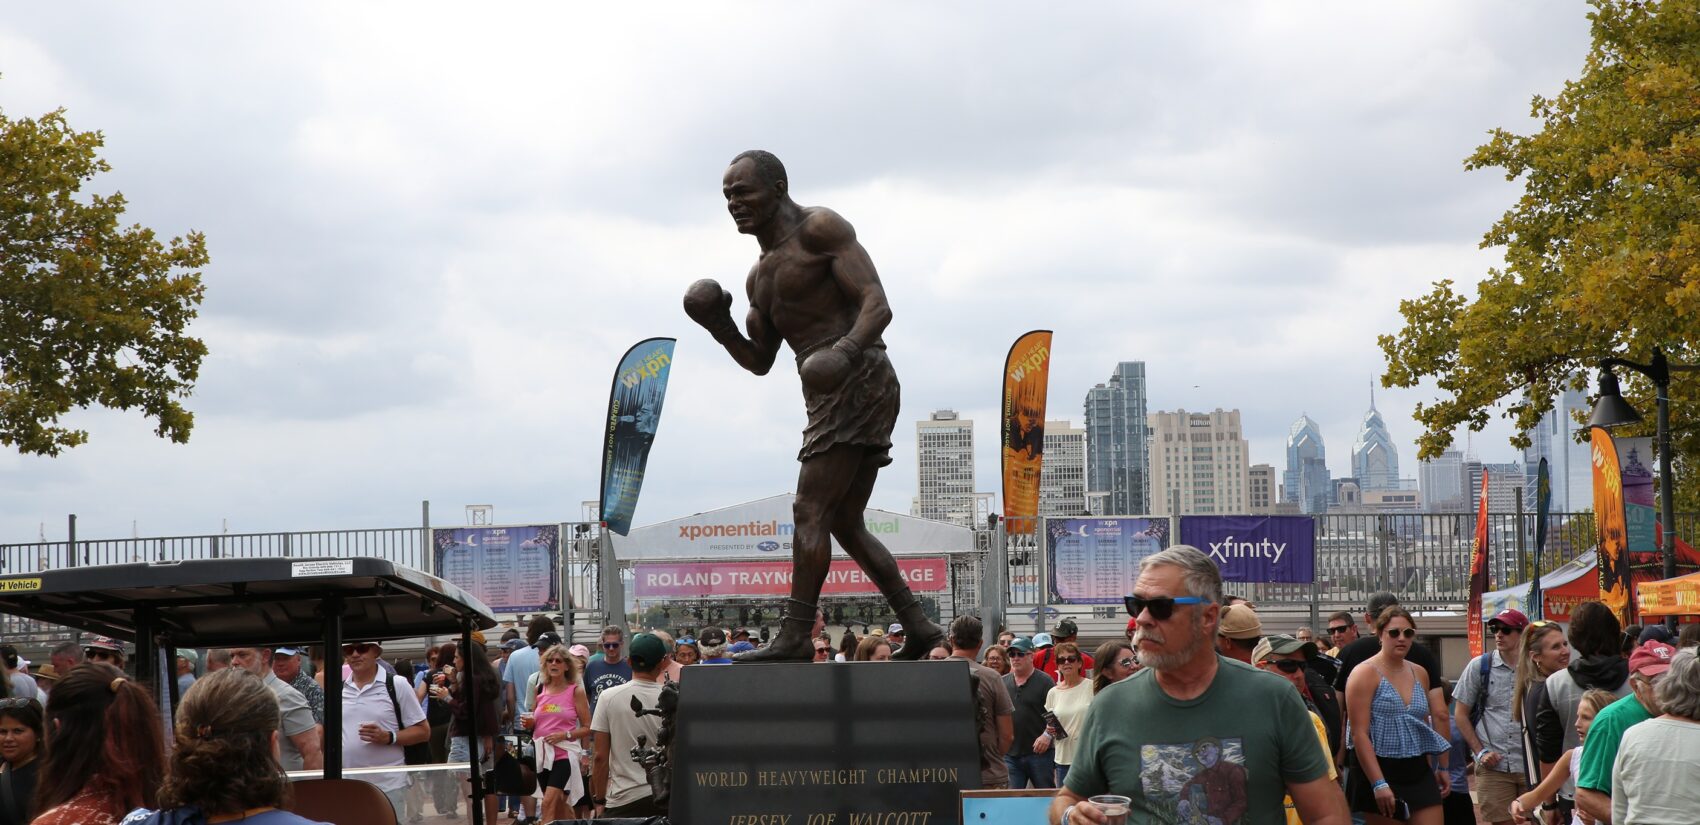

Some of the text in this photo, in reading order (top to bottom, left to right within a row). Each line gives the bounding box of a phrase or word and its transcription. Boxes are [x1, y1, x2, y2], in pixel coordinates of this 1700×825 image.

[621, 353, 671, 389] wxpn
[1011, 346, 1049, 383] wxpn
[1190, 419, 1211, 427] Hilton
[1592, 445, 1621, 498] wxpn
[1208, 536, 1287, 564] xfinity
[8, 580, 38, 590] Vehicle
[647, 572, 722, 587] ROLAND
[728, 571, 794, 585] TRAYN
[900, 568, 934, 582] AGE
[1675, 590, 1697, 612] wxpn
[593, 673, 627, 685] HANDCRAFTED
[695, 767, 959, 787] WORLD HEAVYWEIGHT CHAMPION
